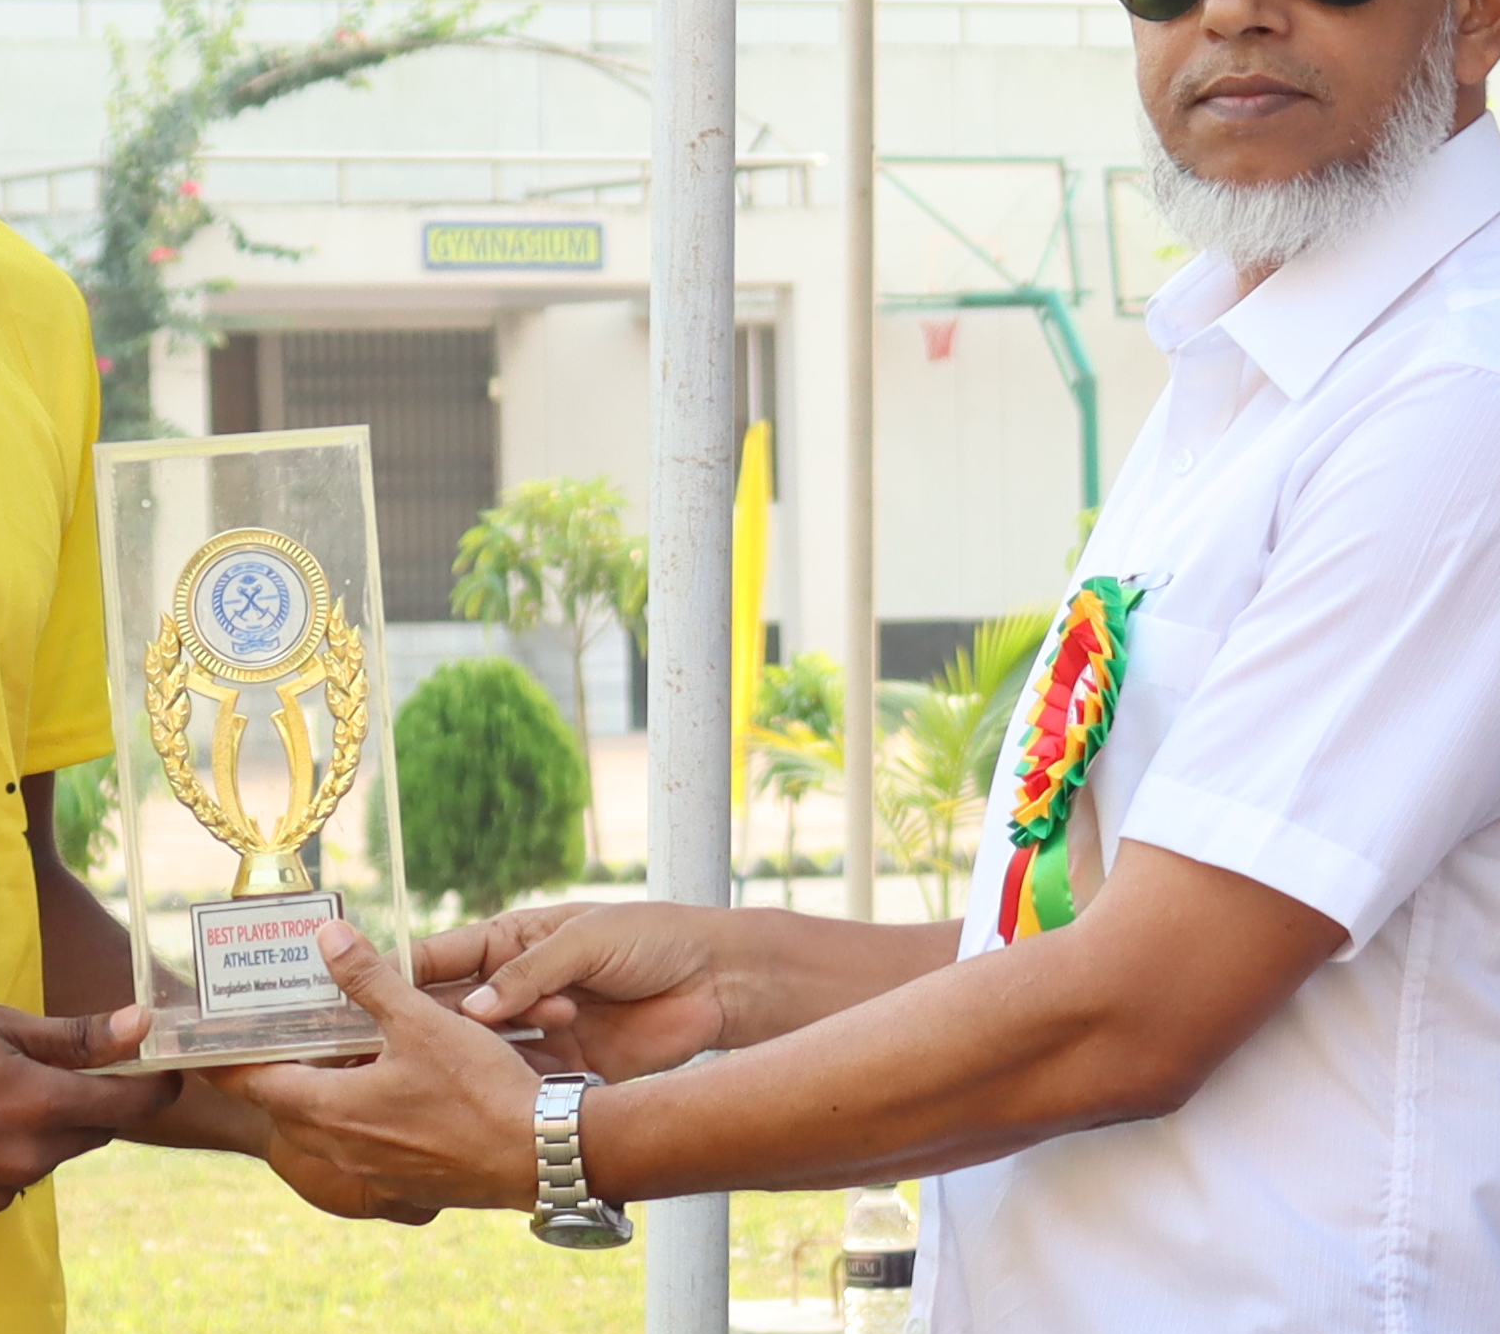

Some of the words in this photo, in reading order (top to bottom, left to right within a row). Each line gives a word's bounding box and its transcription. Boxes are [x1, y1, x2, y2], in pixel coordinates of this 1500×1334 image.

[432, 227, 589, 259] GYMNASIUM
[207, 927, 234, 946] BEST
[238, 923, 279, 942] PLAYER
[223, 946, 309, 968] ATHLETE-2023
[212, 980, 252, 998] Bangladesh
